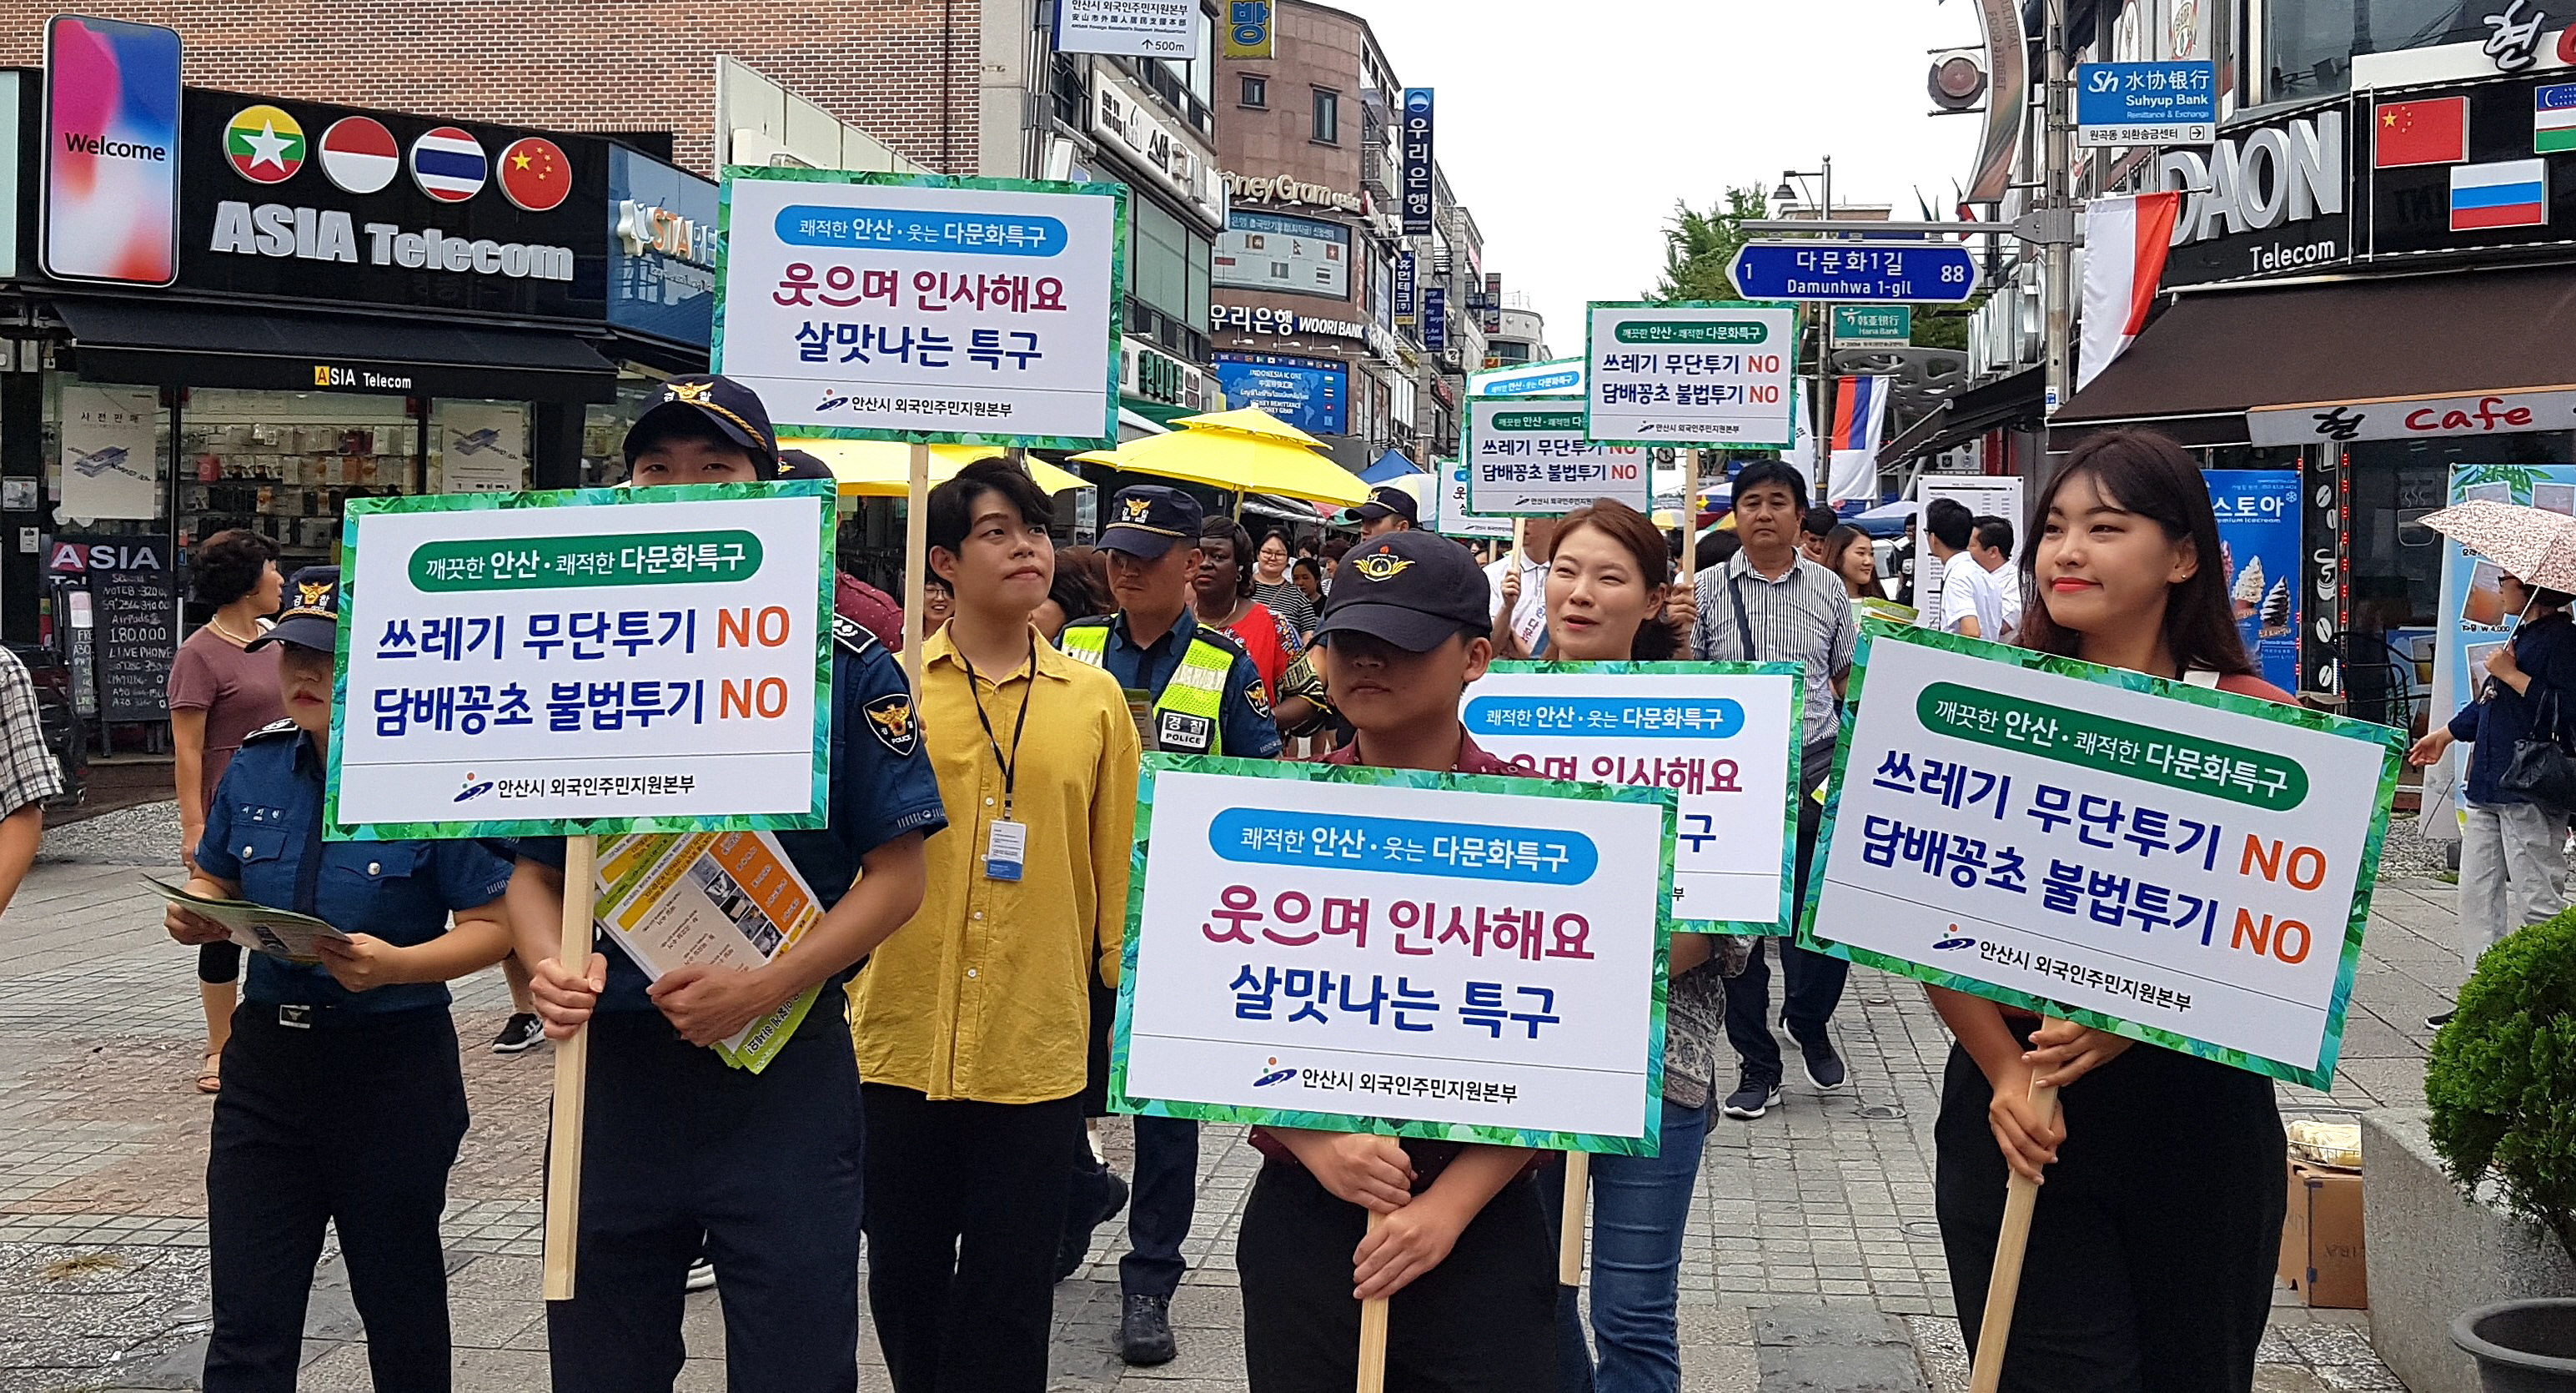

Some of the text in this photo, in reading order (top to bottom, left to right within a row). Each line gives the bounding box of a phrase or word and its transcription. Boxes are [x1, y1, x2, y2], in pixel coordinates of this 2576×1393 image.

[1155, 41, 1184, 51] 500m
[2088, 69, 2210, 93] Sh 水协银行
[2126, 94, 2208, 108] Suhyup Bank
[64, 132, 166, 162] Welcome
[2090, 128, 2178, 140] 원곡동 외환송금센터
[1407, 117, 1429, 216] 우리은행
[2162, 109, 2343, 247] DAON
[210, 200, 575, 282] ASIA Telecom
[799, 219, 849, 239] 쾌적한
[944, 222, 1047, 249] 다문화특구
[1745, 263, 1752, 279] 1
[2250, 240, 2335, 272] Telecom
[772, 261, 1067, 313] 웃으며 인사해요
[1788, 279, 1912, 297] Damunhwa 1-gil
[1941, 265, 1964, 282] 88
[1211, 304, 1364, 339] 우리은행 WOORI BANK
[1706, 327, 1760, 339] 다문화특구
[795, 320, 1043, 371] 살맛나는 특구
[316, 368, 411, 389] ASIA Telecom
[1602, 355, 1780, 375] 쓰레기 무단투기 NO
[851, 396, 1013, 419] 안산시 외국인주민지원본부
[1602, 383, 1779, 405] 담배꽁초 불법투기 NO
[1482, 440, 1530, 455] 쓰레기
[1482, 464, 1637, 482] 담배꽁초 불법투기 NO
[50, 545, 160, 570] ASIA
[425, 556, 486, 581] 깨끗한
[620, 542, 746, 576] 다문화특구
[375, 606, 791, 661] 쓰레기 무단투기 NO
[373, 676, 788, 737] 담배꽁초 불법투기 NO
[1485, 709, 1532, 726] 쾌적한
[1623, 707, 1724, 731] 다문화특구
[1166, 733, 1201, 744] POLICE
[1934, 699, 2000, 733] 깨끗한
[2146, 743, 2289, 799] 다문화특구
[497, 773, 695, 799] 안산시 외국인주민지원본부
[1871, 750, 2327, 893] 쓰레기 무단투기 NO
[1240, 826, 1306, 855] 쾌적한
[1432, 834, 1569, 873] 다문화특구
[1862, 815, 2312, 965] 담배꽁초 불법투기 NO
[1202, 884, 1595, 962] 웃으며 인사해요
[1980, 940, 2192, 1013] 안산시 외국인주민지원본부
[1229, 963, 1561, 1040] 살맛나는 특구
[1301, 1067, 1519, 1105] 안산시 외국인주민지원본부
